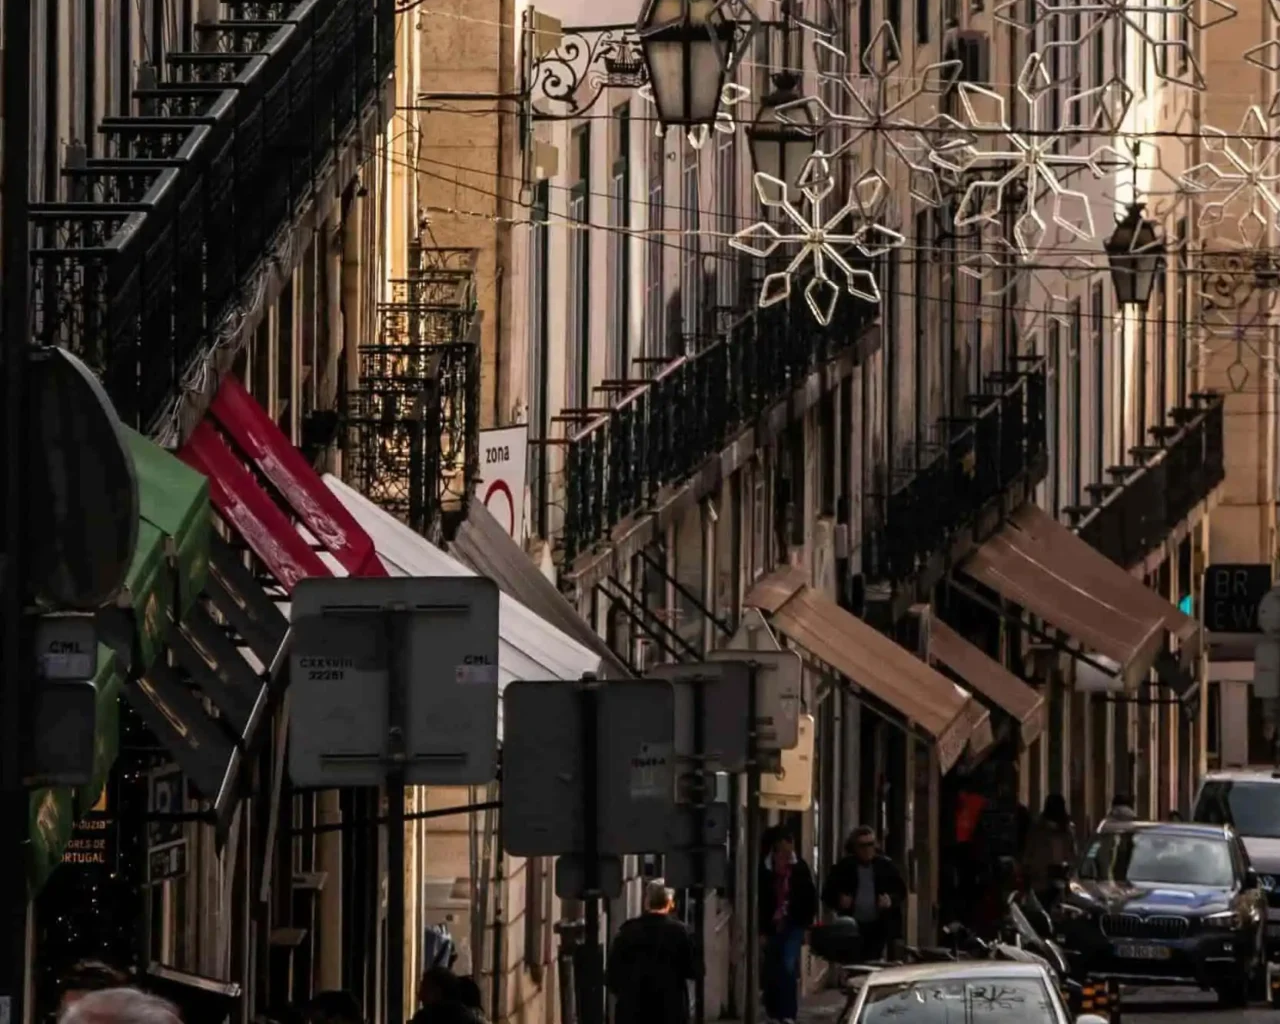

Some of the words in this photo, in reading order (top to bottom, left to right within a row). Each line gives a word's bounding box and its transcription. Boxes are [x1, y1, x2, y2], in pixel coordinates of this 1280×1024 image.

[486, 446, 509, 464] zona
[49, 640, 83, 653] CML
[464, 655, 491, 665] CML
